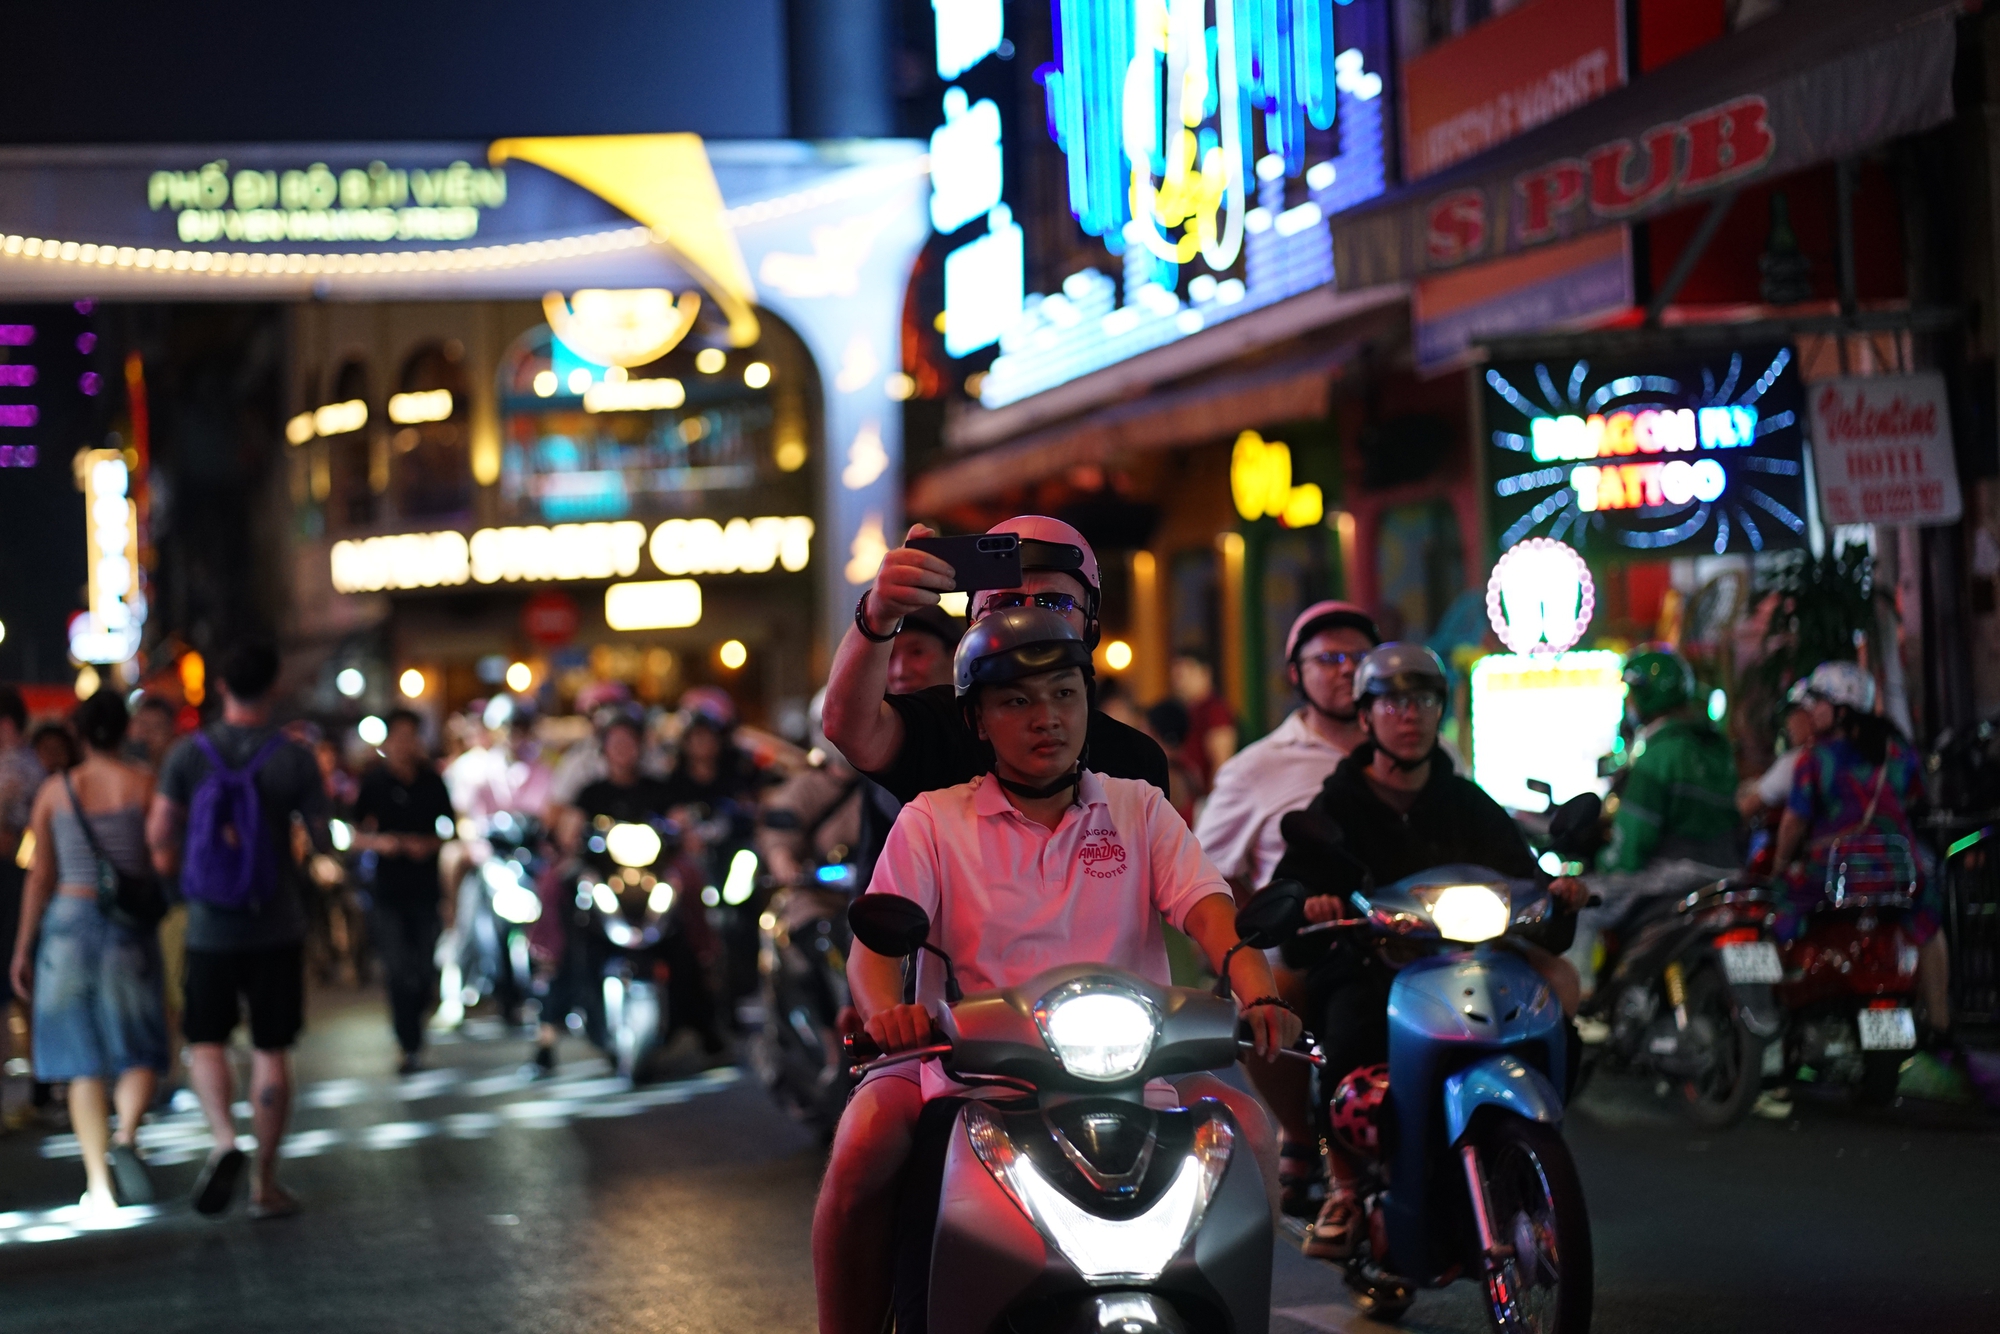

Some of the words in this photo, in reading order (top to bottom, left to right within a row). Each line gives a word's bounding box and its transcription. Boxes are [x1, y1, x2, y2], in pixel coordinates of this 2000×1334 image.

[1427, 188, 1485, 264] S
[1513, 94, 1777, 246] PUB
[1531, 408, 1697, 462] DRAGON
[1846, 446, 1924, 479] HOTEL
[1571, 458, 1726, 512] TATTOO
[1078, 843, 1126, 862] AMAZING
[1084, 863, 1128, 879] SCOOTER
